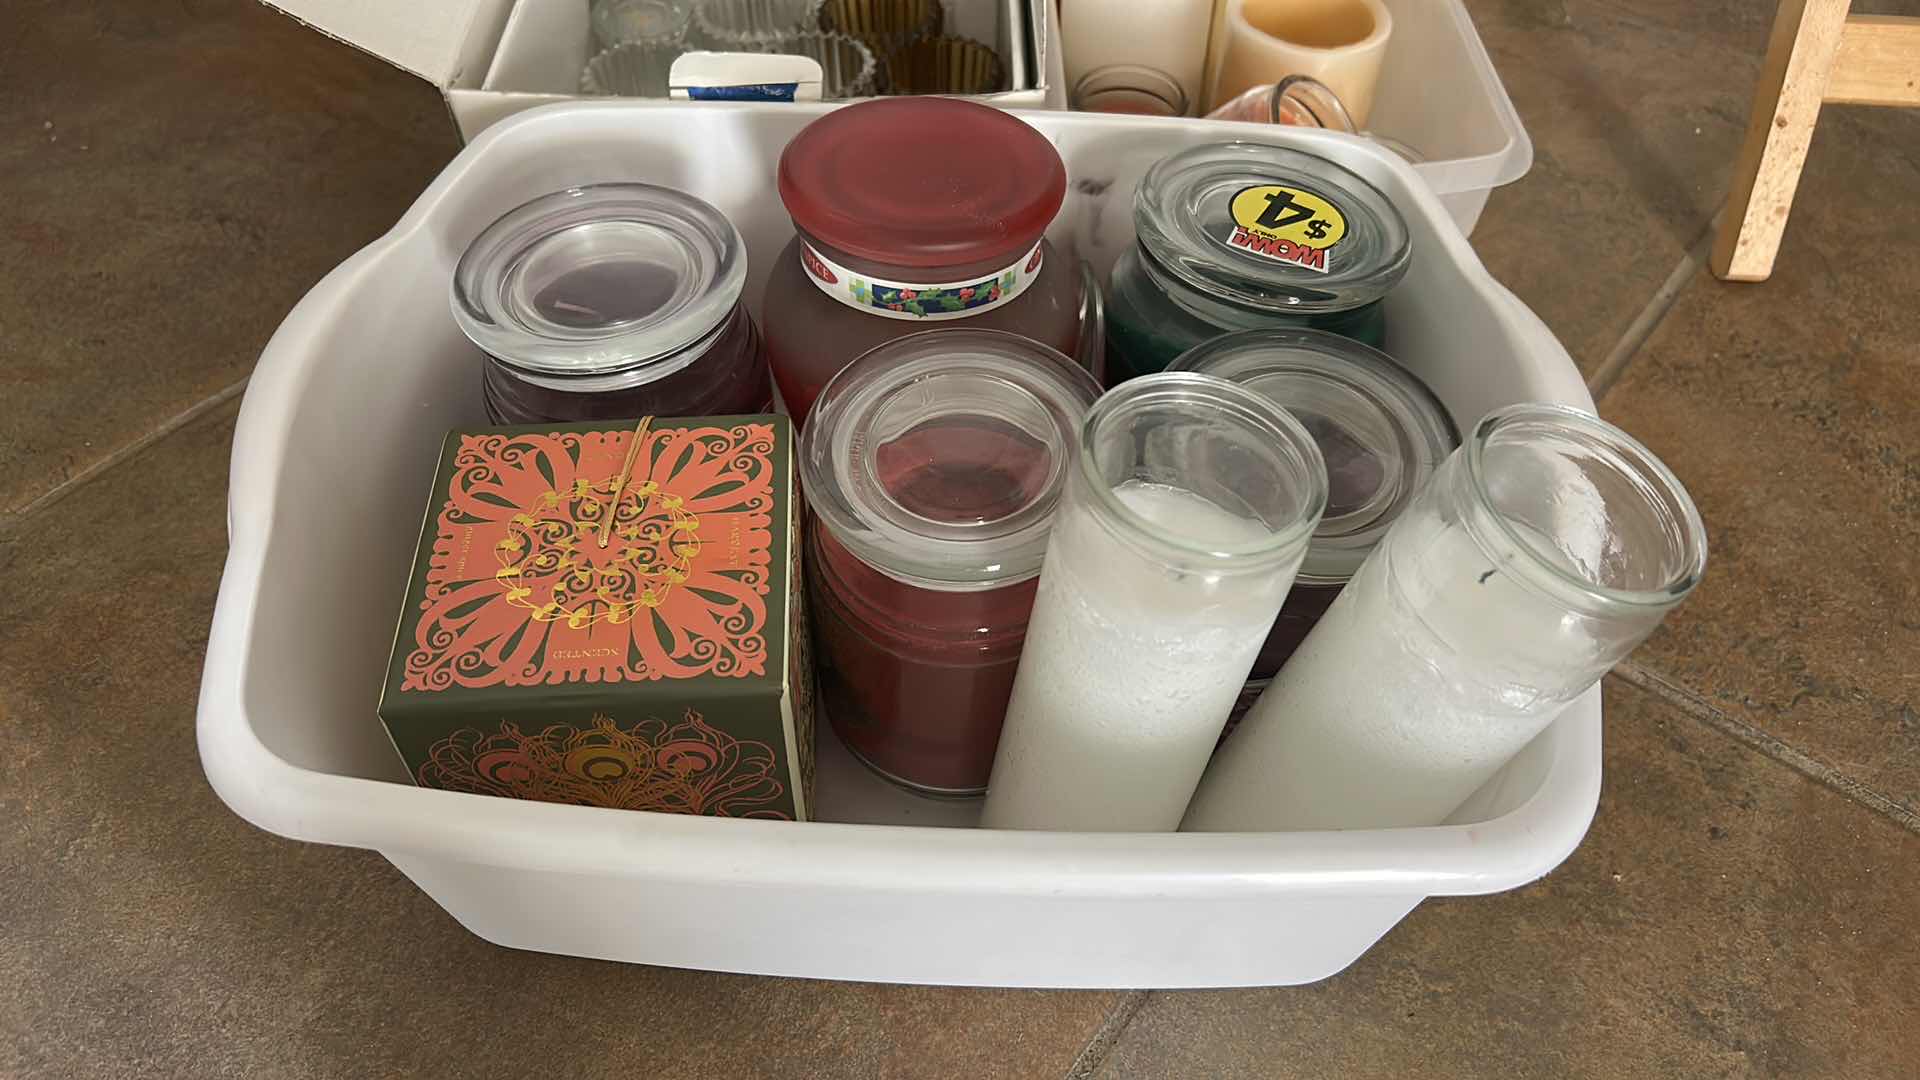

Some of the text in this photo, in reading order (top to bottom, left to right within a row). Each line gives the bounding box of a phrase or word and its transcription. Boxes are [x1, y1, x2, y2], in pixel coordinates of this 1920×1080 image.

[1252, 229, 1278, 240] ONLY
[1230, 226, 1326, 270] WOW!
[552, 647, 619, 659] SCENTED
